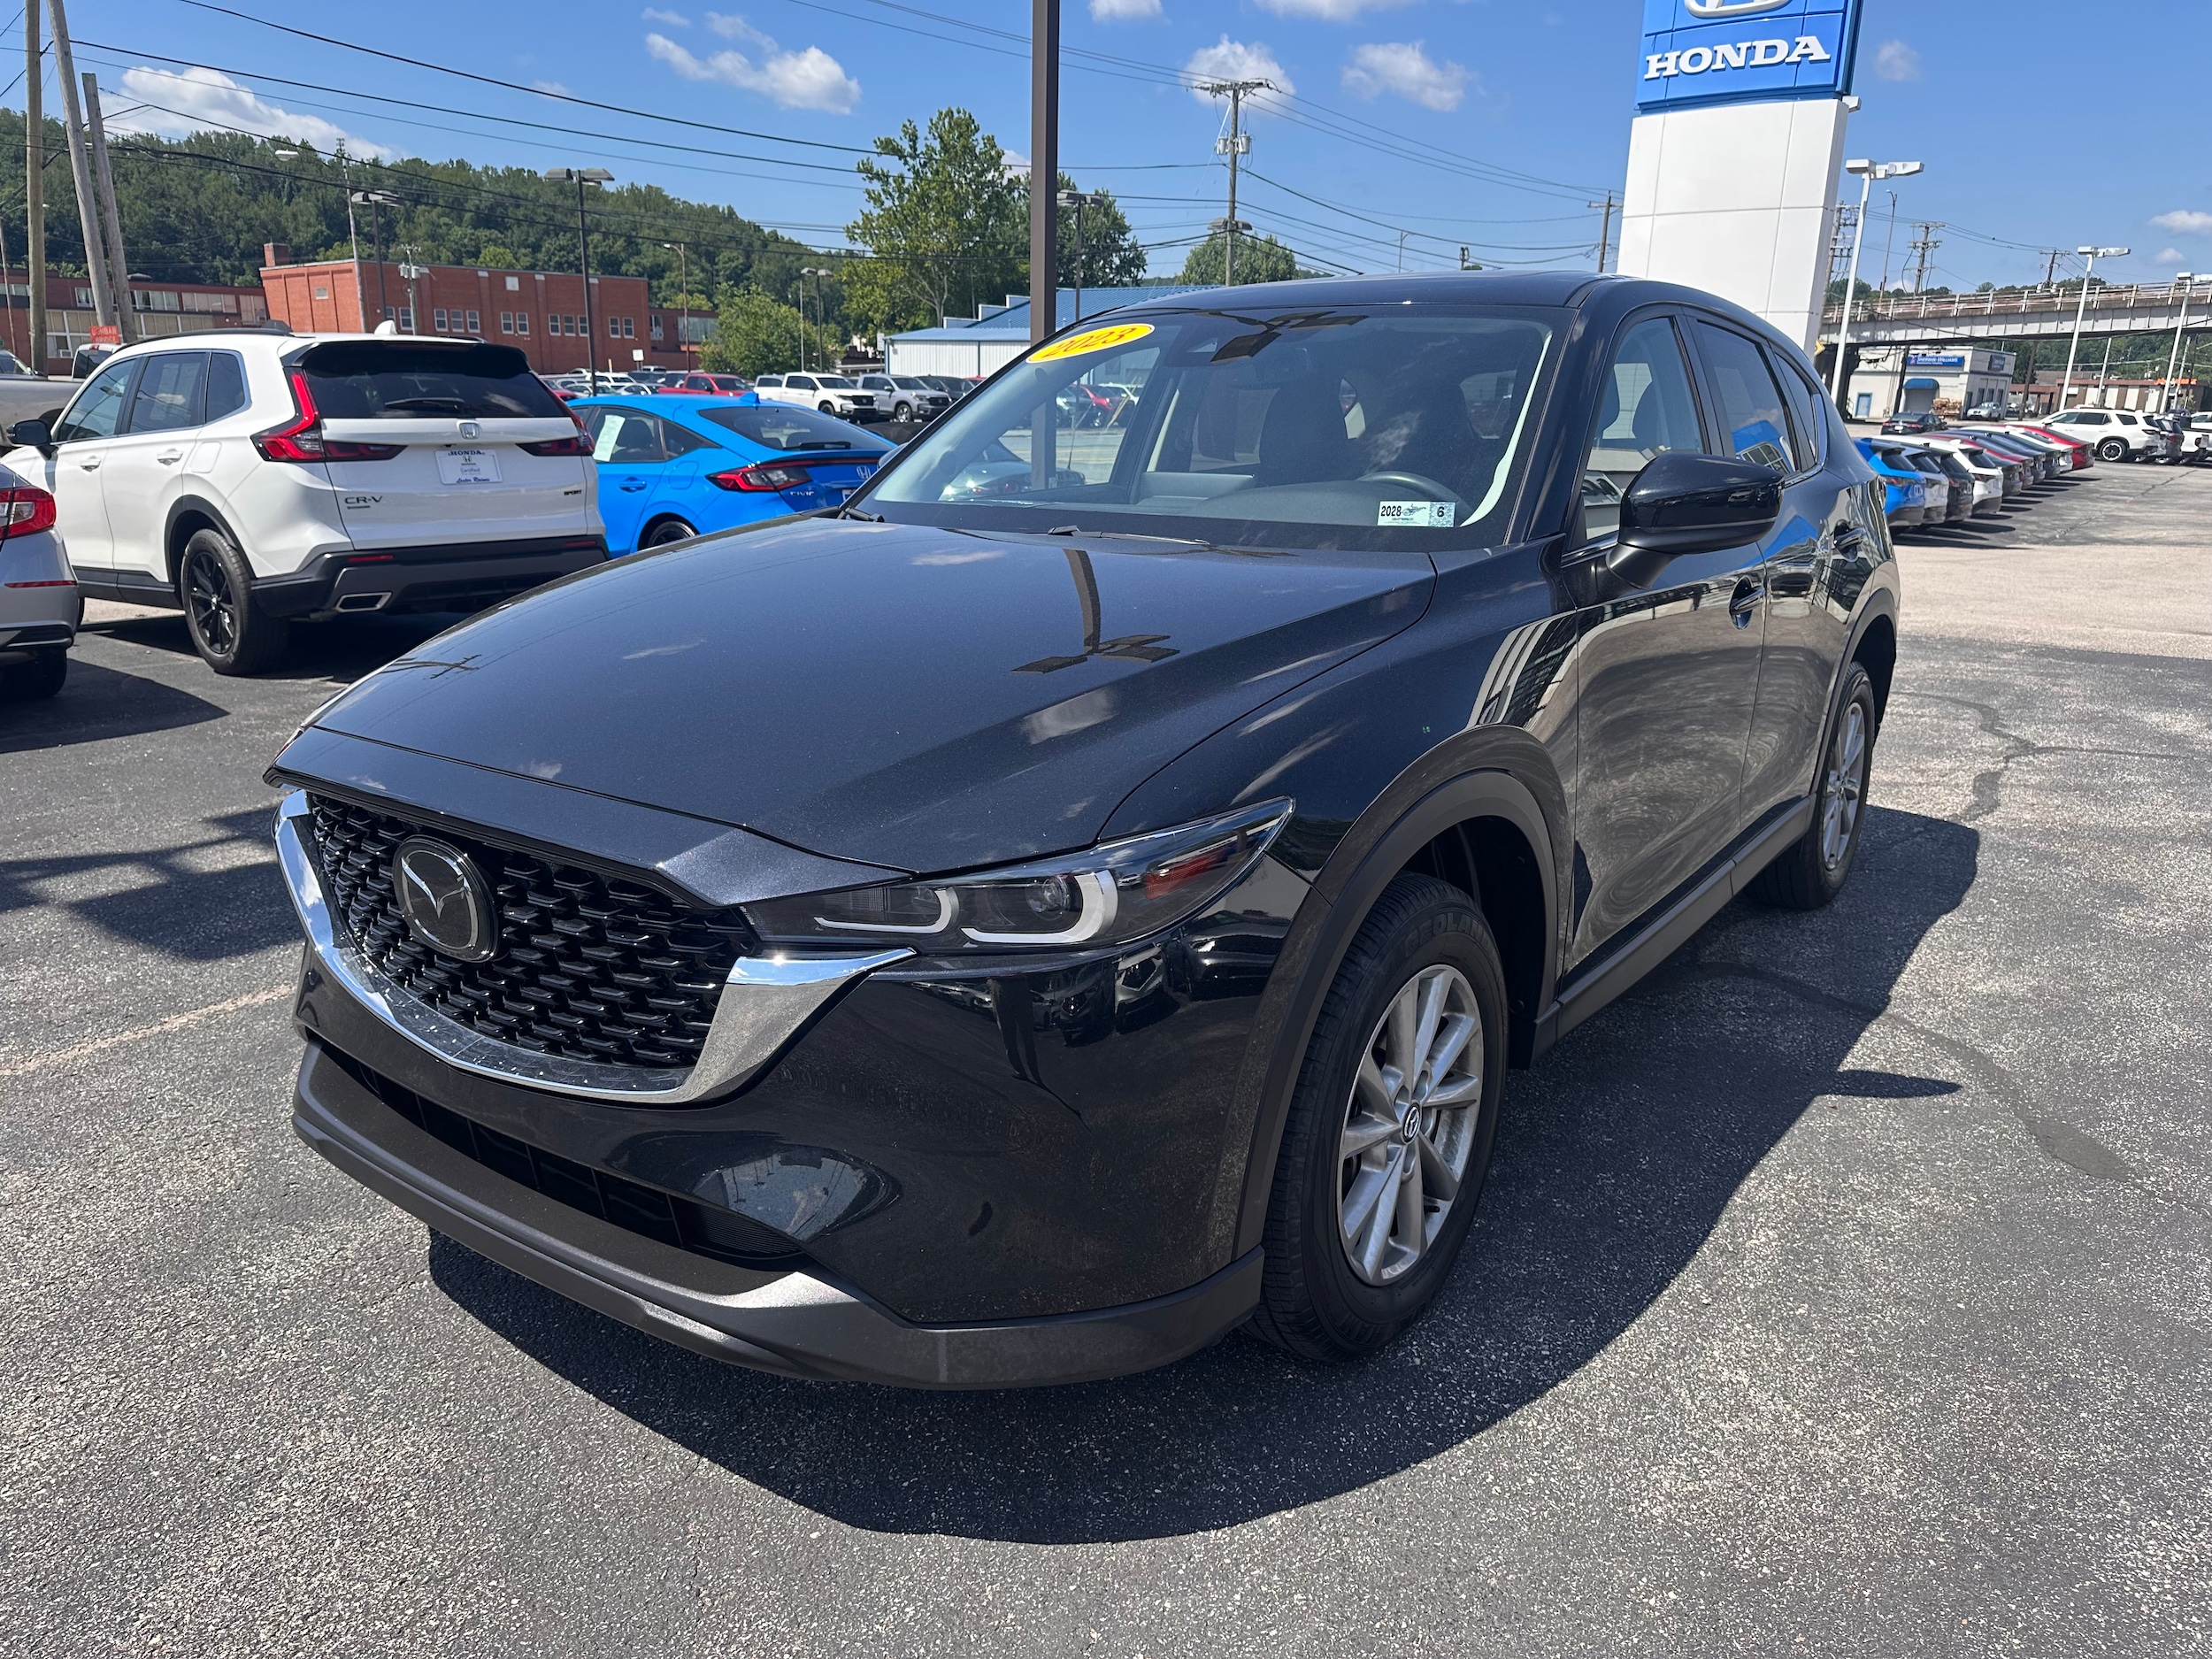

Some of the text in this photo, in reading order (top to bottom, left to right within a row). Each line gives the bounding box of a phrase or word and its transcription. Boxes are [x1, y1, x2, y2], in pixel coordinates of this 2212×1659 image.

[1644, 35, 1832, 80] HONDA
[1041, 327, 1137, 358] 2023
[344, 495, 383, 504] CR-V
[1380, 505, 1445, 518] 2028 6
